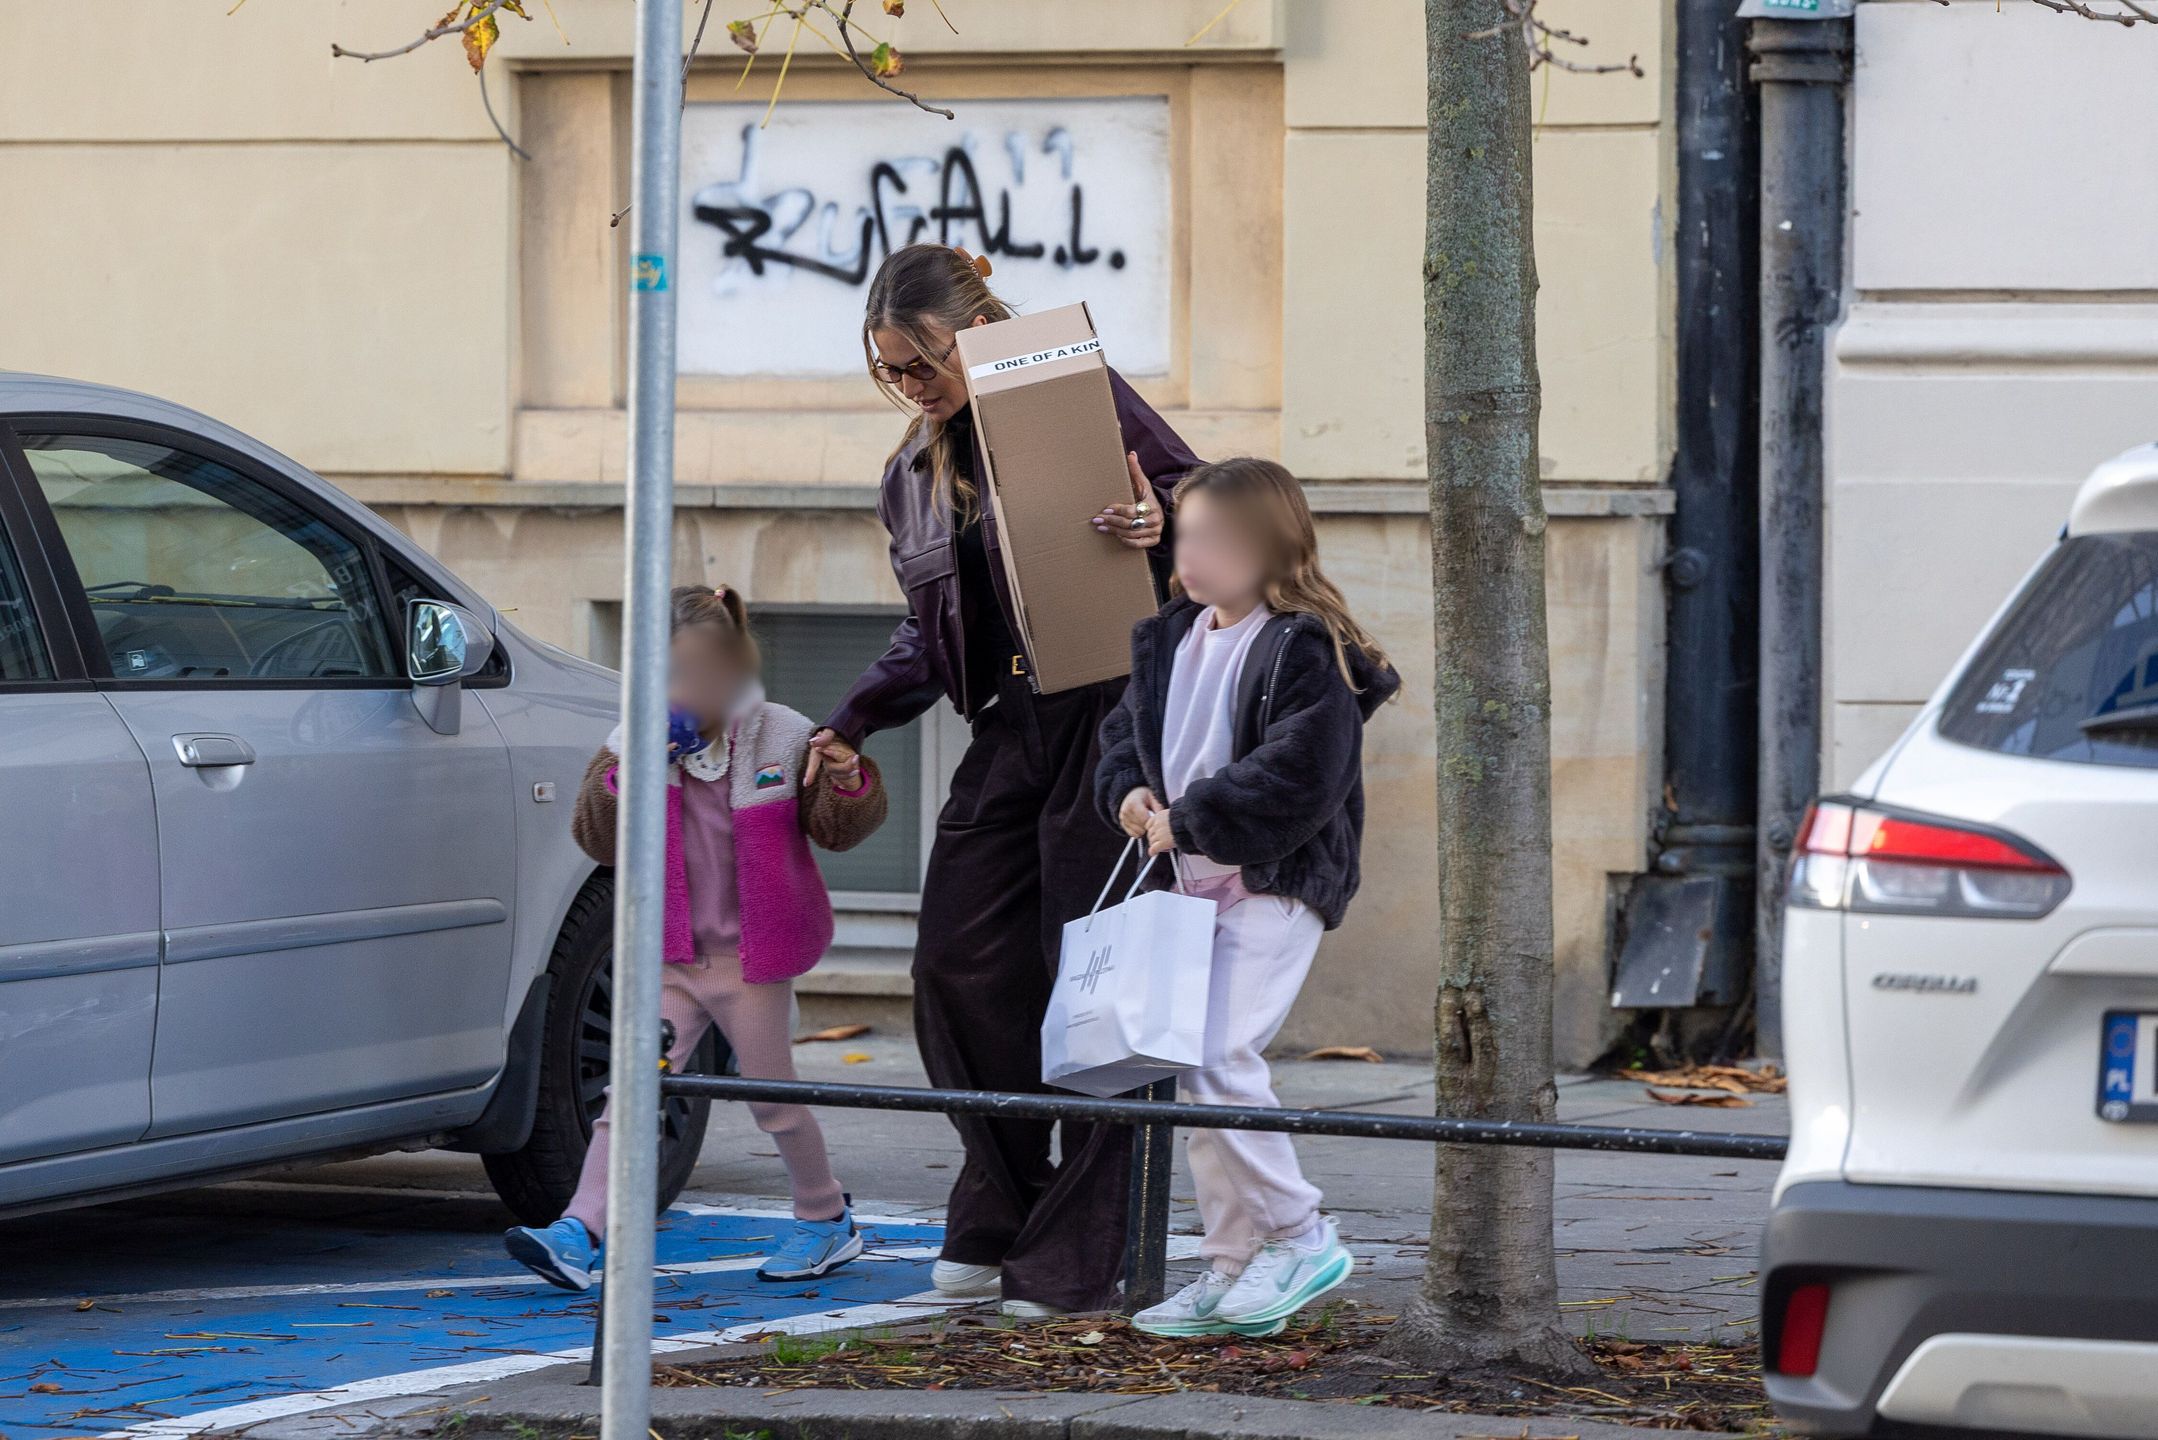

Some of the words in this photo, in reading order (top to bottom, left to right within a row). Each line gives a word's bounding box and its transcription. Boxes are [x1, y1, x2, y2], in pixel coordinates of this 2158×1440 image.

[994, 357, 1029, 371] ONE
[1032, 352, 1053, 362] OF
[1057, 349, 1068, 357] A
[1071, 340, 1100, 354] KIN
[2106, 1068, 2131, 1092] PL
